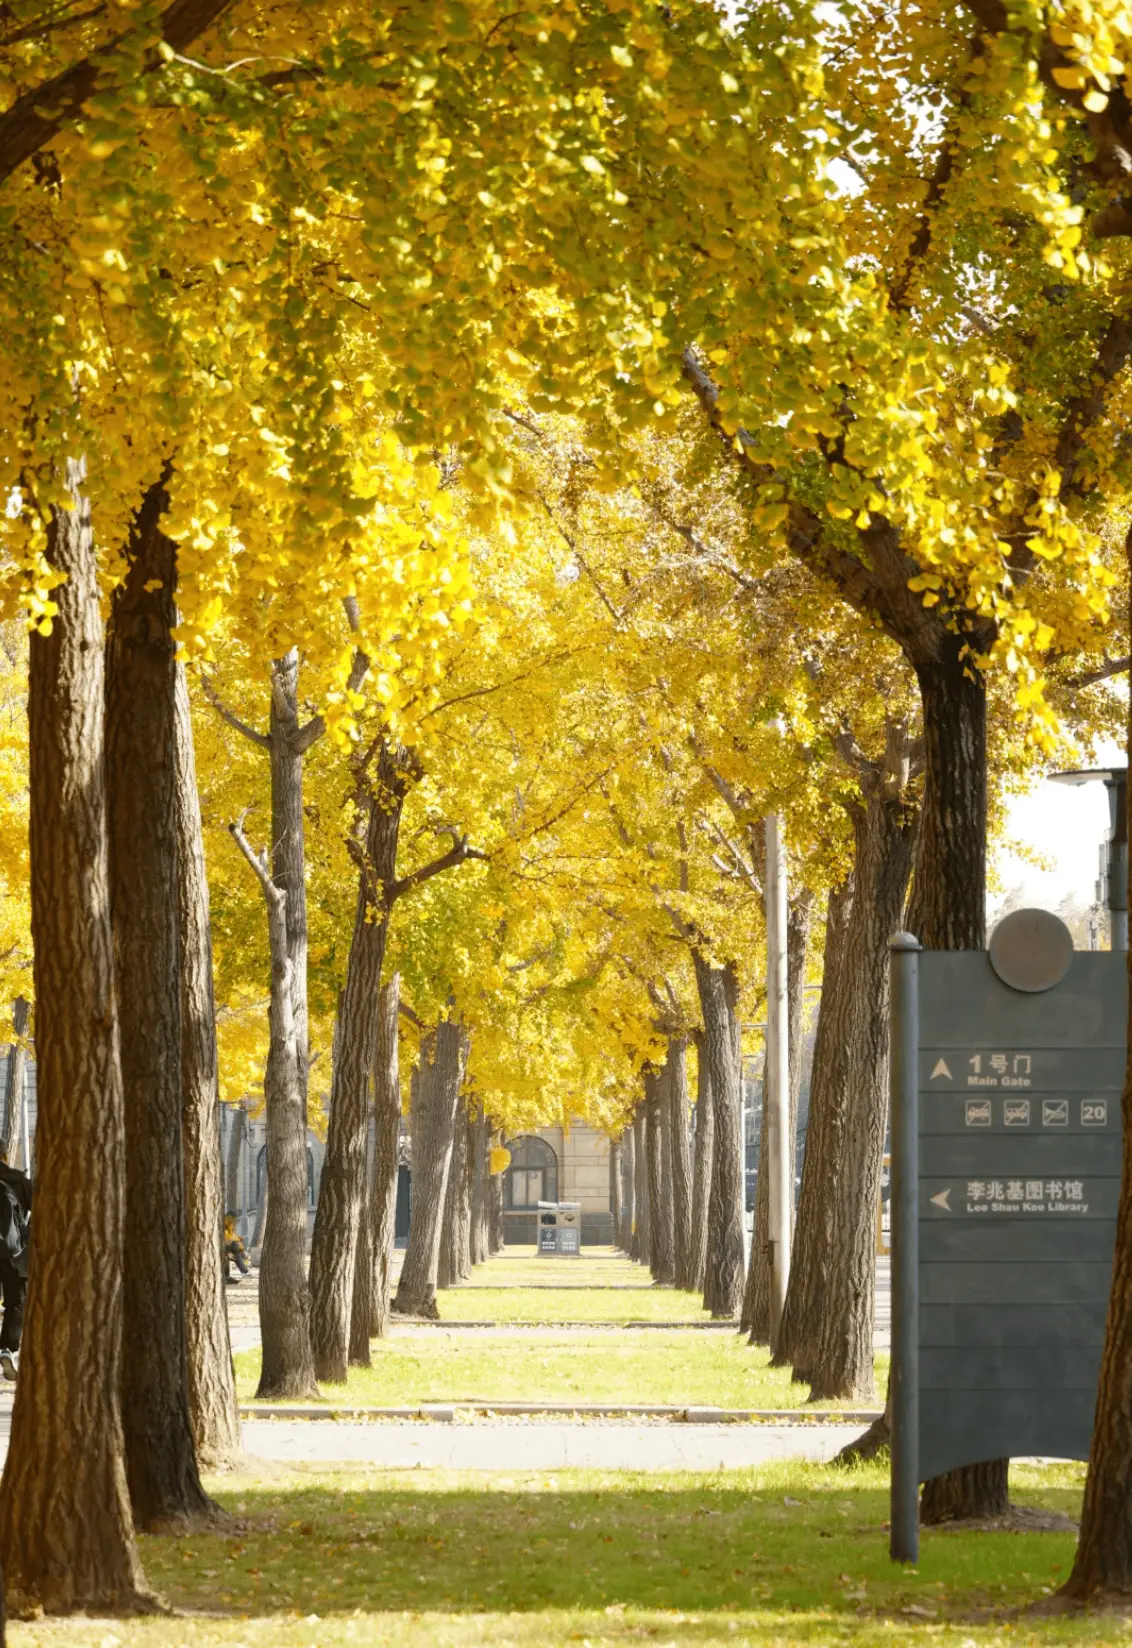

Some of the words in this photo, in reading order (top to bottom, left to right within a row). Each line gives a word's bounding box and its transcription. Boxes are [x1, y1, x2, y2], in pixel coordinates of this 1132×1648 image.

[969, 1054, 1032, 1074] 1号门
[967, 1076, 998, 1086] Main
[1001, 1075, 1032, 1087] Gate
[1083, 1105, 1106, 1120] 20
[966, 1180, 1084, 1201] 李兆基图书馆
[966, 1203, 989, 1212] Lee
[991, 1202, 1020, 1212] Shau
[1022, 1202, 1045, 1212] Kee
[1047, 1202, 1089, 1213] Library
